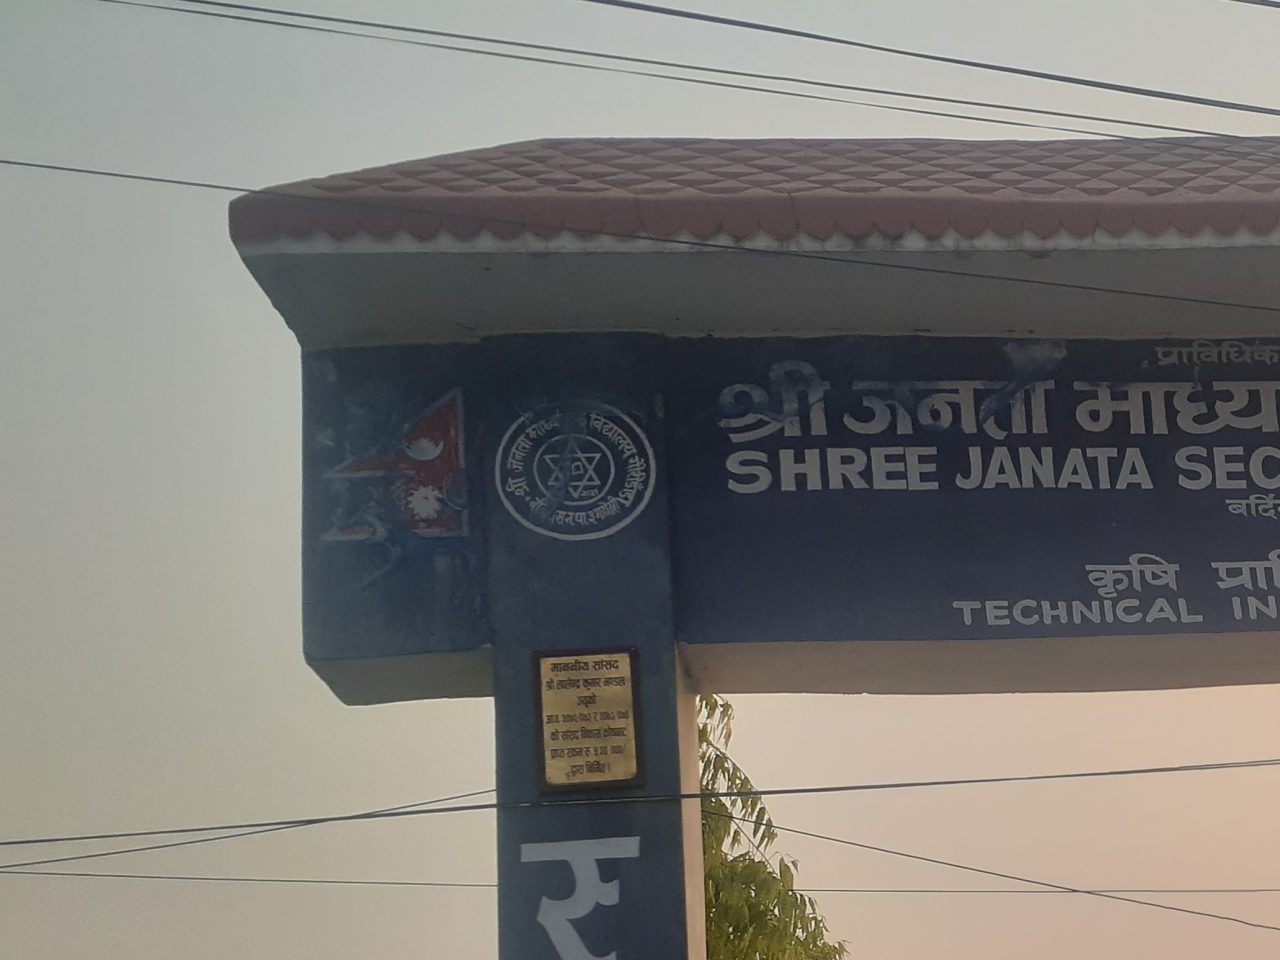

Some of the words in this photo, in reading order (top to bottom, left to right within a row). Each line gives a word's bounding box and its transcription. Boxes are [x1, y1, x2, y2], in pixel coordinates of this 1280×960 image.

[717, 360, 832, 443] श्री
[843, 380, 1056, 440] जनता
[726, 446, 939, 493] SHREE
[955, 446, 1154, 490] JANATA
[1085, 552, 1180, 598] कृषि
[953, 597, 1204, 626] TECHNICAL
